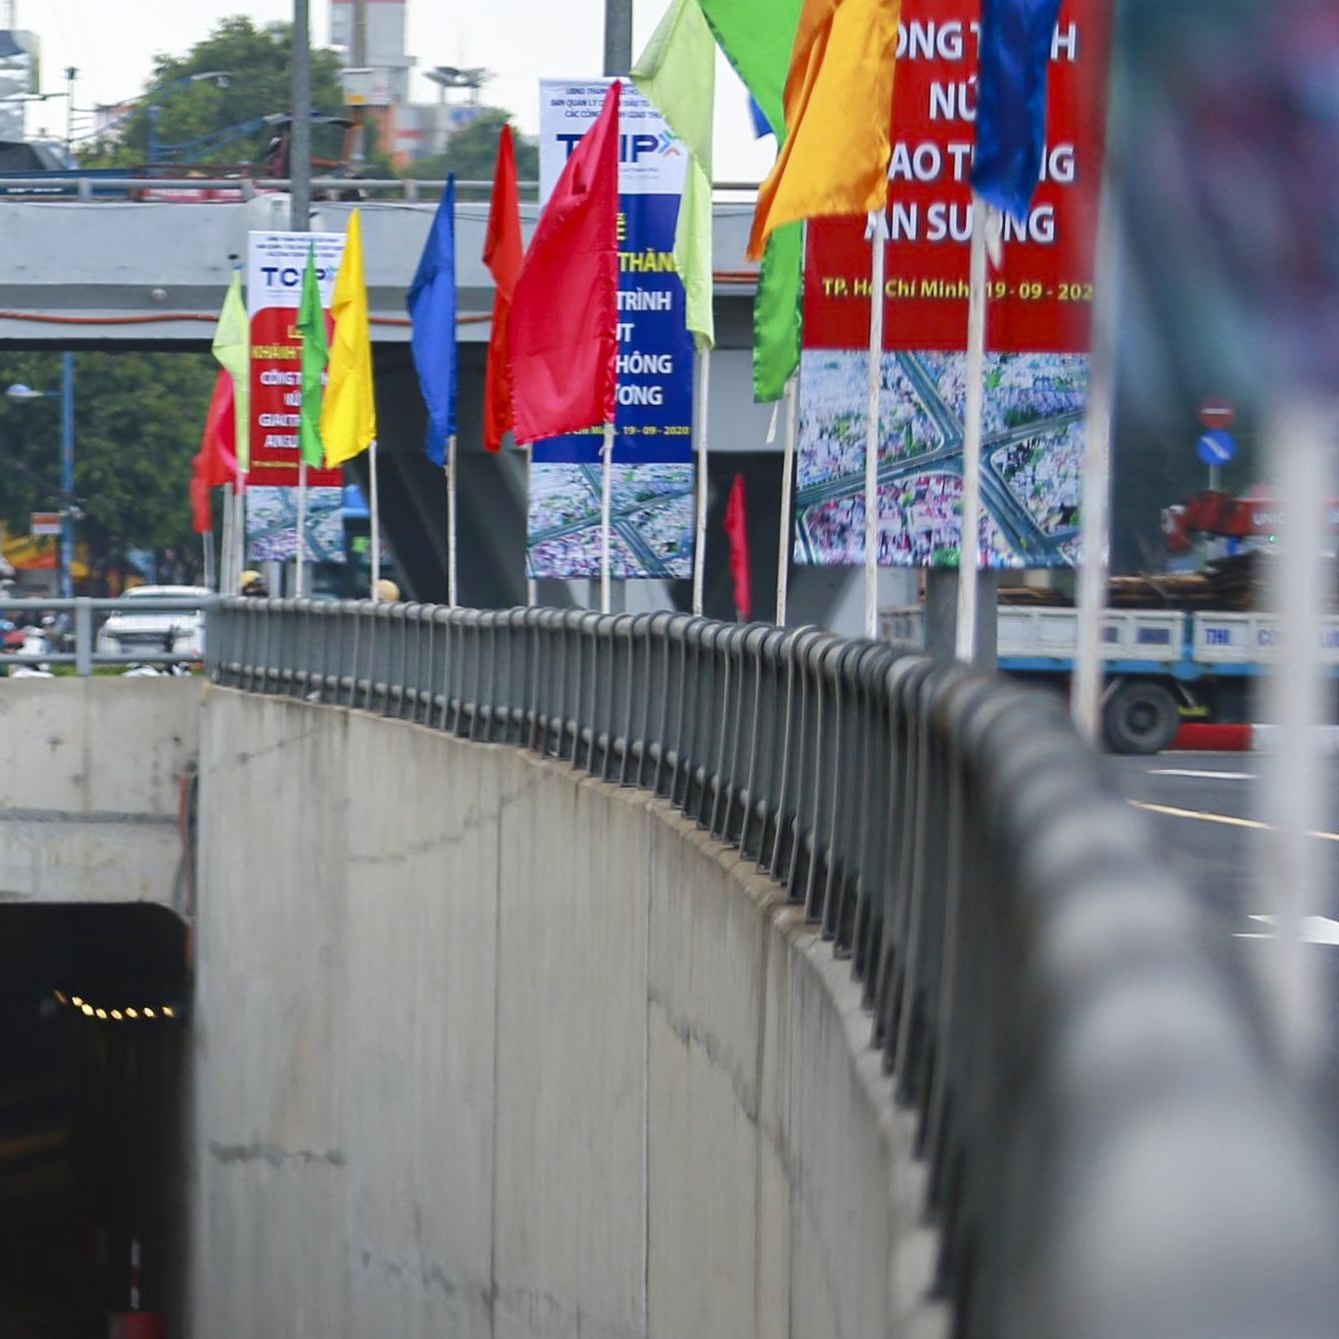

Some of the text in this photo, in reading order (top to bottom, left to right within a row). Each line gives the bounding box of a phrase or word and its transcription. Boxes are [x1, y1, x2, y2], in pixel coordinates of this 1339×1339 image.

[896, 21, 963, 60] NG
[929, 76, 980, 121] NÚ
[556, 134, 659, 162] TIP
[888, 143, 941, 181] AO
[618, 248, 675, 272] THÀN
[616, 287, 671, 311] TRÌNH
[822, 278, 848, 296] TP.
[985, 281, 1006, 297] 19
[1019, 283, 1042, 298] 09
[1058, 284, 1094, 300] 202
[616, 351, 672, 374] HÔNG
